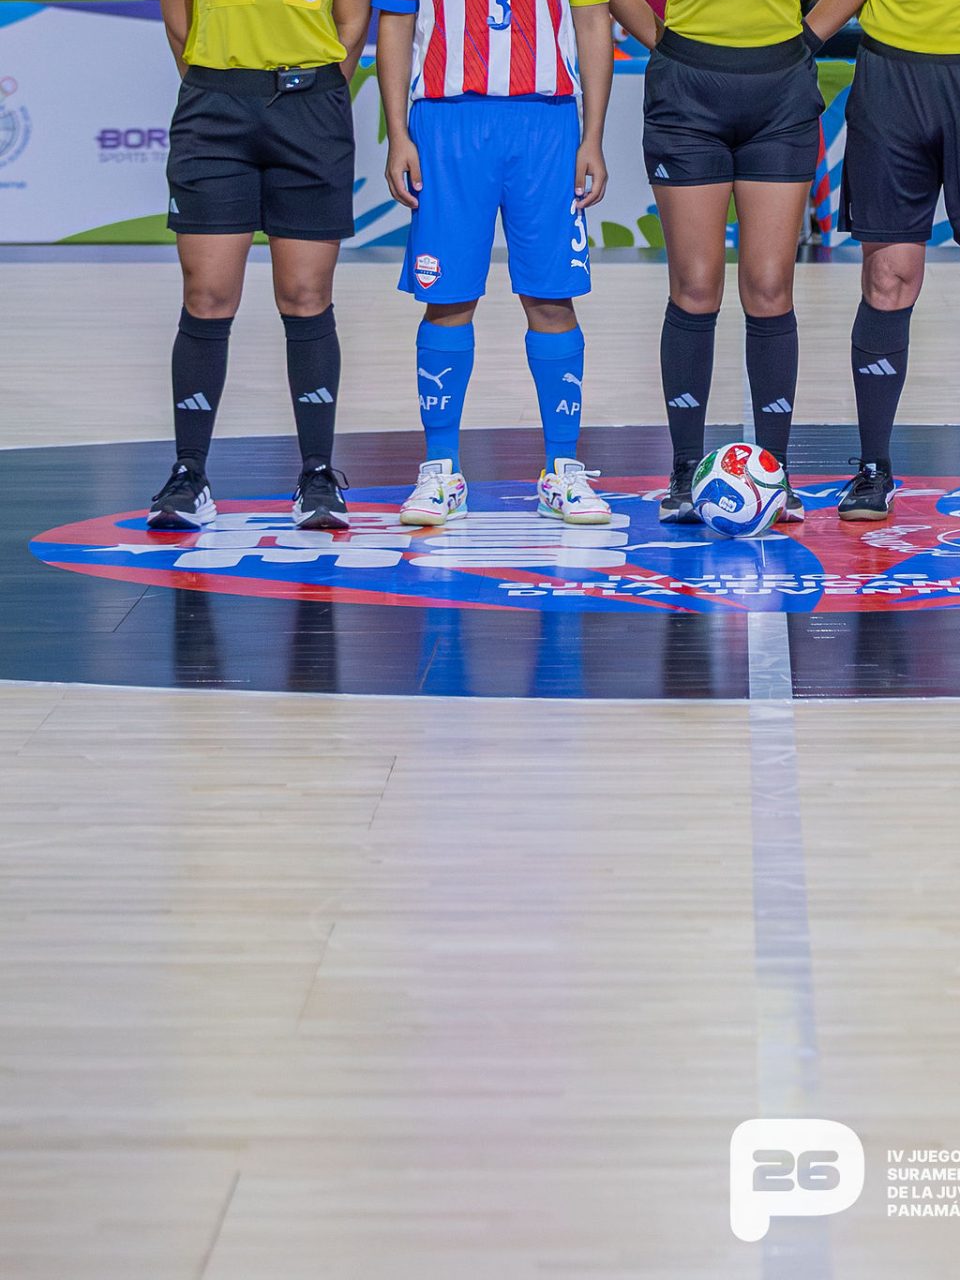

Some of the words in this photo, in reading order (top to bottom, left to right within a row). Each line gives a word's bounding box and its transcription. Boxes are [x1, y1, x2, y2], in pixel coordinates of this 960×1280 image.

[97, 128, 167, 149] BOR
[419, 395, 451, 411] APF
[556, 400, 580, 416] AP
[684, 573, 930, 581] JUEGOS
